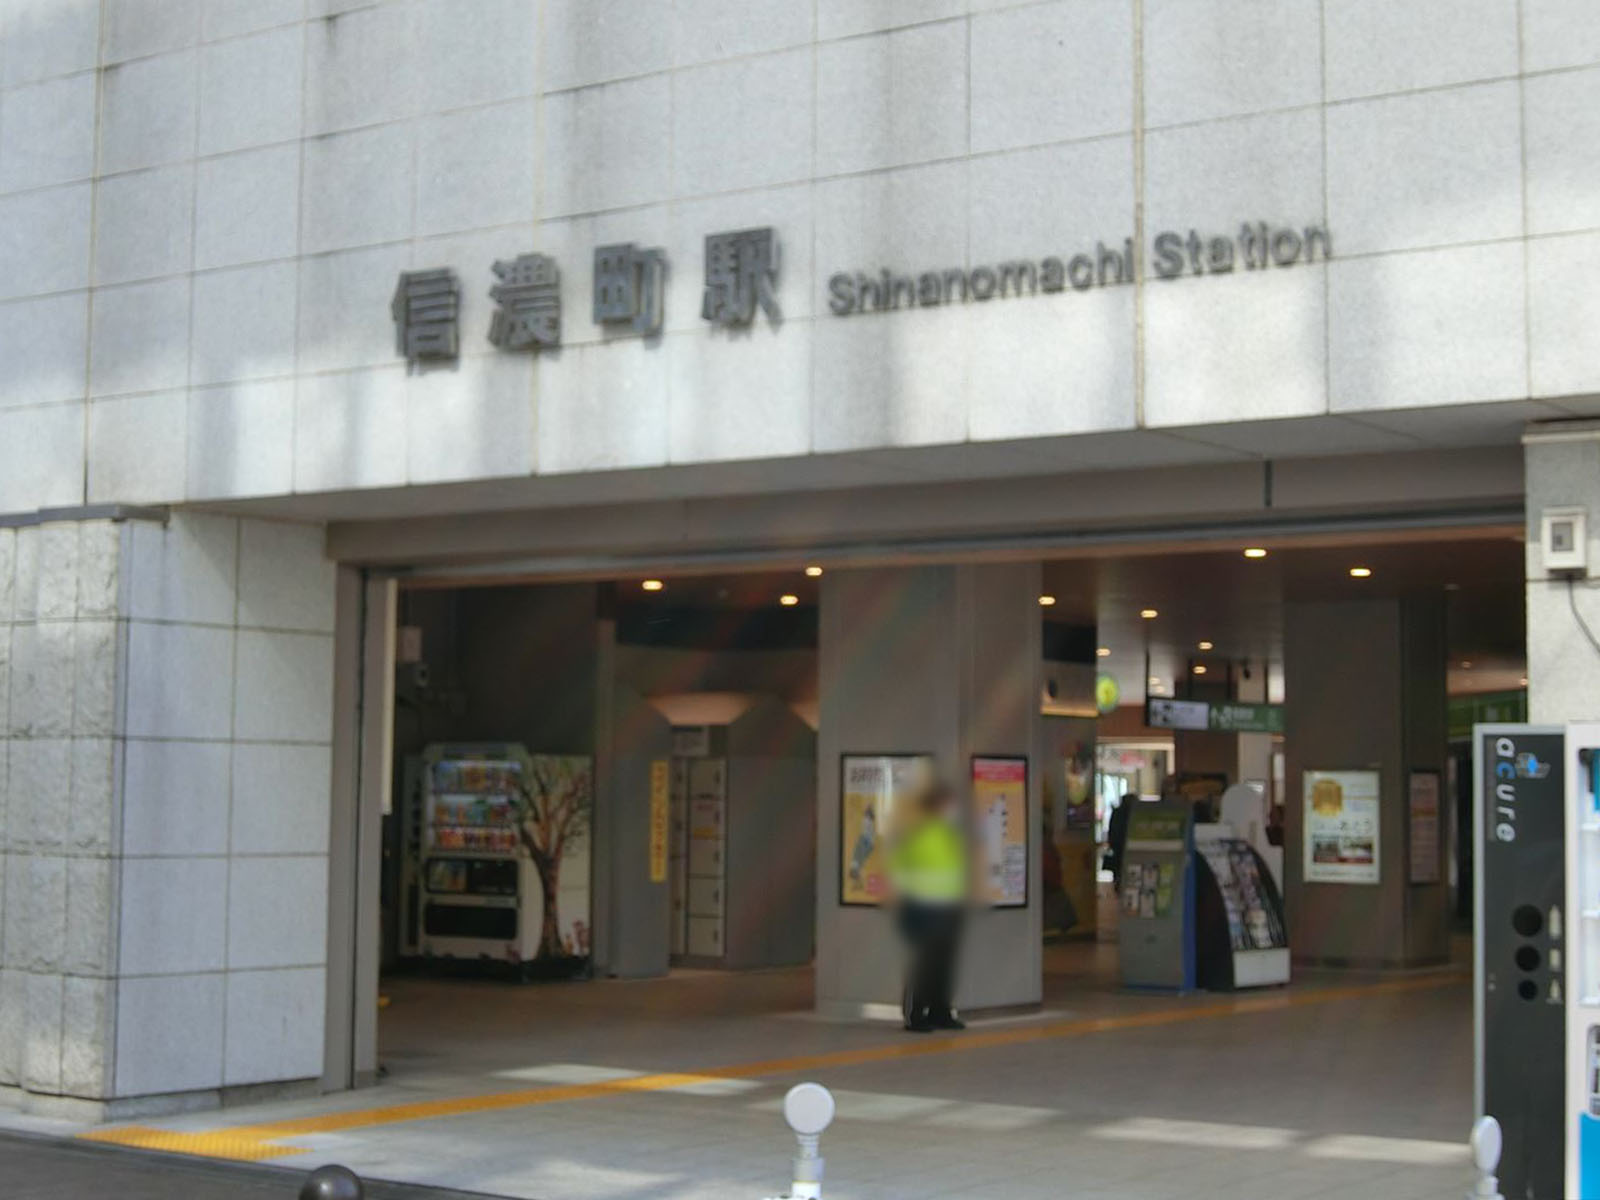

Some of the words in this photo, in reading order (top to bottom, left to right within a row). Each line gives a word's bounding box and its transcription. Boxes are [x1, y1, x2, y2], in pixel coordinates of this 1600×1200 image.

[392, 227, 783, 372] 信濃町駅
[828, 238, 1135, 316] Shinanomachi
[1153, 221, 1332, 280] Station
[1496, 737, 1516, 842] acure
